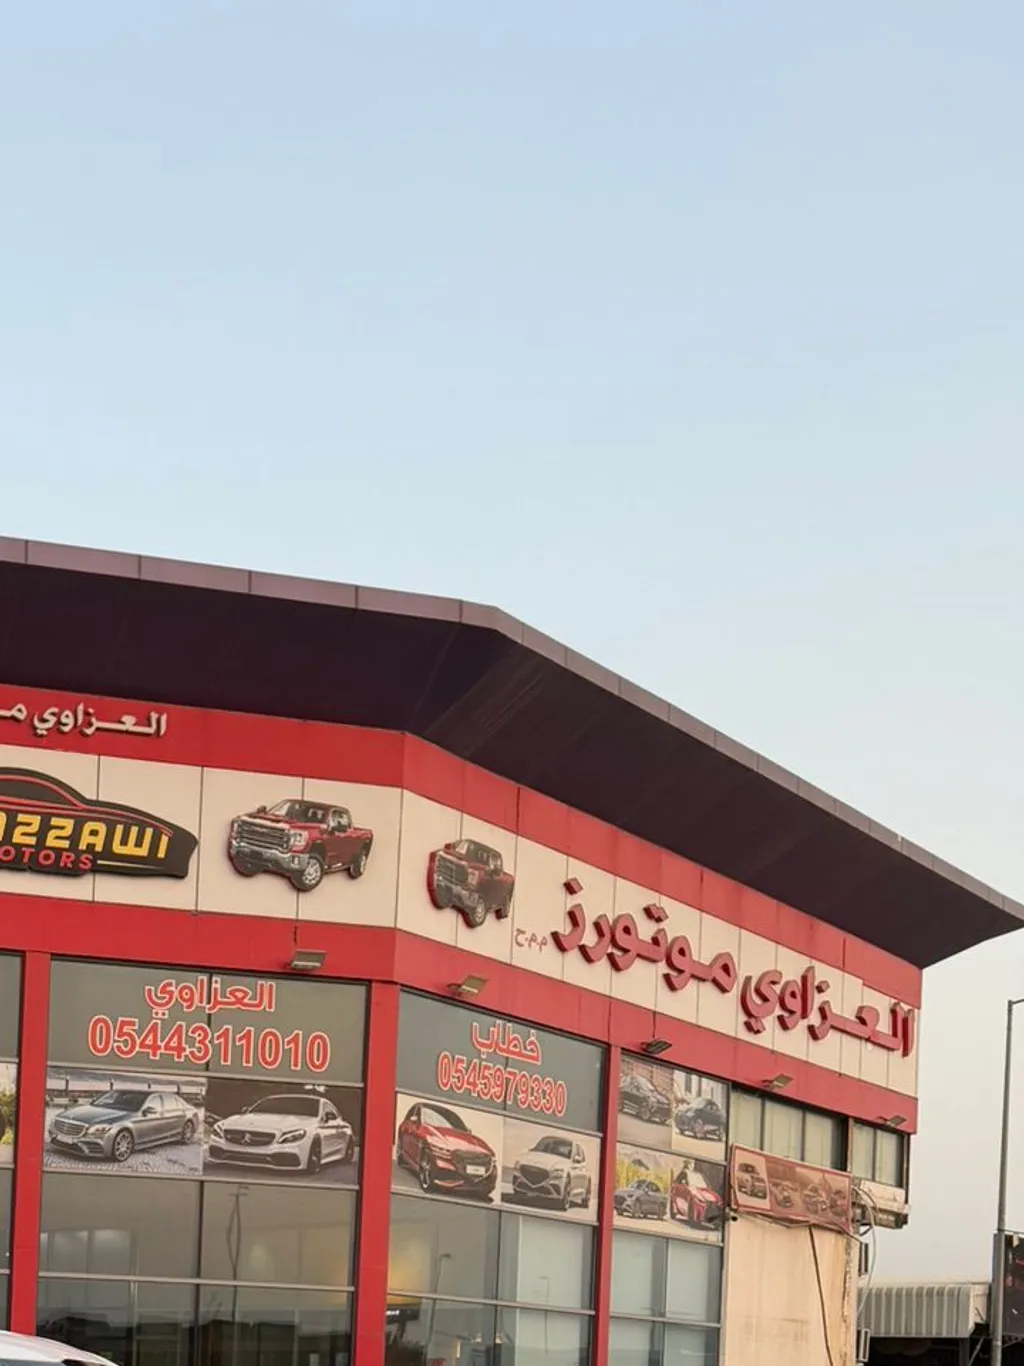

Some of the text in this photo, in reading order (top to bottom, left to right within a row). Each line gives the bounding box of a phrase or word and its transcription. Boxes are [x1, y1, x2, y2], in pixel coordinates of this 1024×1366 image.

[33, 702, 168, 736] العزاوي
[550, 877, 916, 1058] العزاوي موتورز
[144, 975, 276, 1020] العزاوي
[88, 1014, 331, 1073] 0544311010
[470, 1020, 542, 1066] خطاب
[437, 1050, 568, 1117] 0545979330
